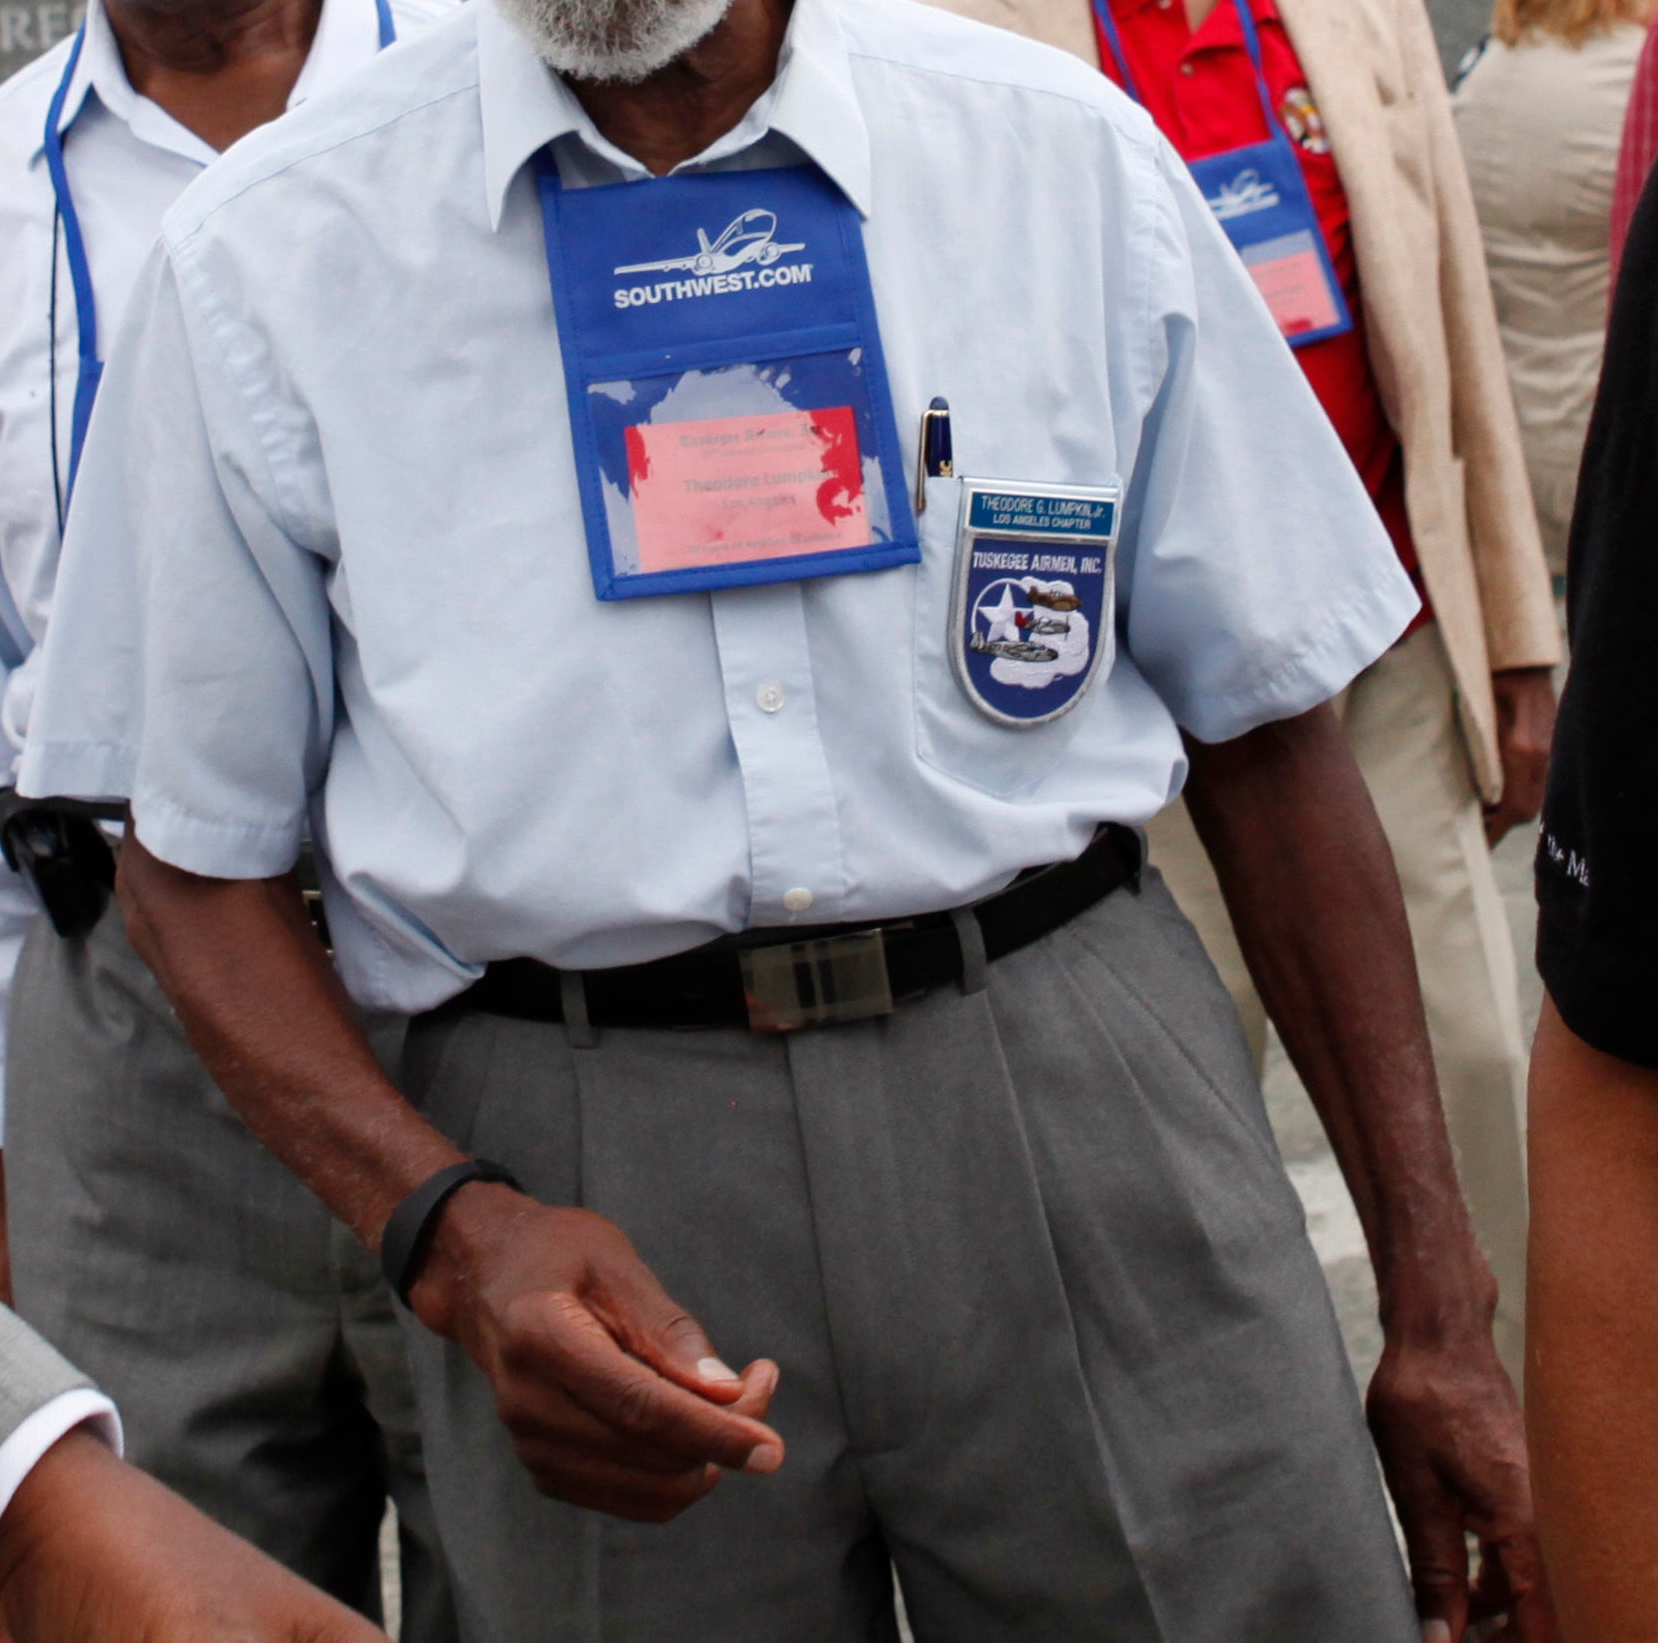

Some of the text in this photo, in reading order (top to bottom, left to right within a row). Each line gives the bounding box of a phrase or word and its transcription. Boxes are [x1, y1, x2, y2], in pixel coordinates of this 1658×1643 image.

[613, 263, 814, 309] SOUTHWEST.COM
[981, 495, 1034, 514] THEODORE
[993, 513, 1092, 530] LOS ANGELES CHAPTER
[973, 551, 1102, 575] TUSKEGEE AIRMEN, INC.
